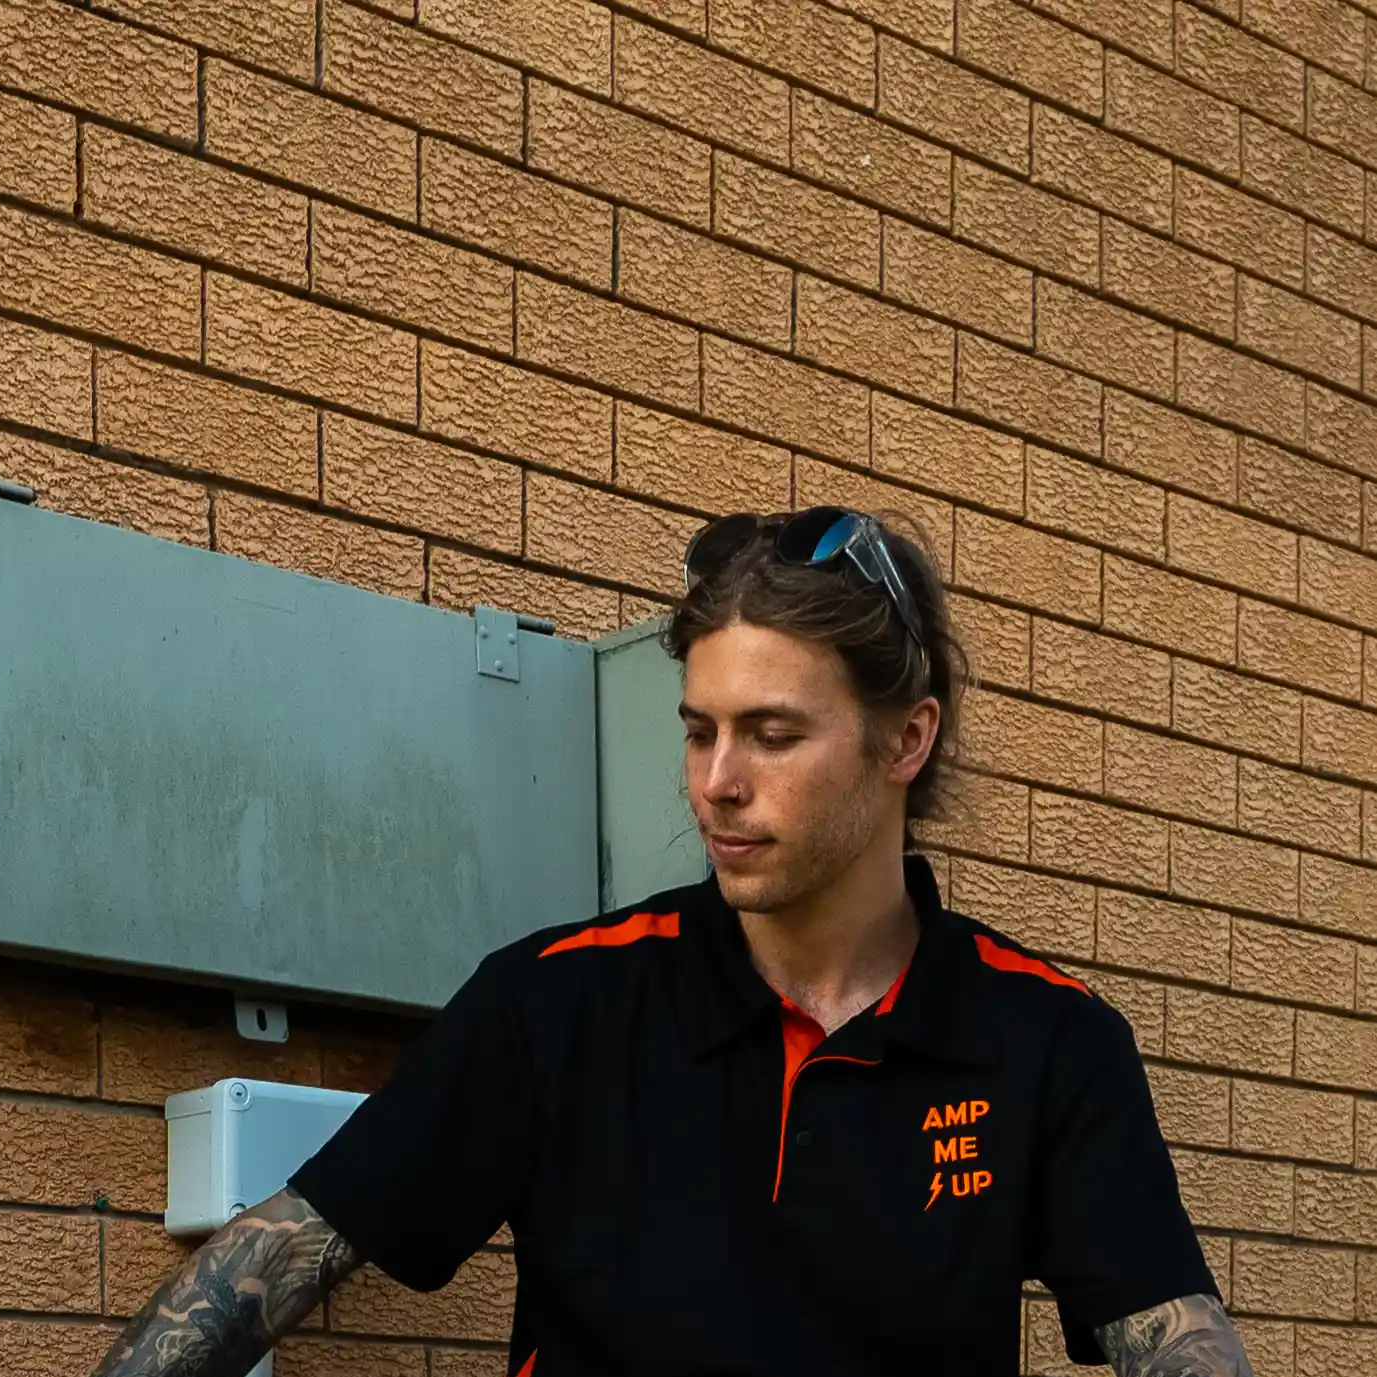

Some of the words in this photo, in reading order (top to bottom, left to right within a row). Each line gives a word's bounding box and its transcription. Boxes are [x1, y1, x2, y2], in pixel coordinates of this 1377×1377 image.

[922, 1099, 990, 1131] AMP
[934, 1136, 978, 1164] ME
[951, 1170, 992, 1196] UP
